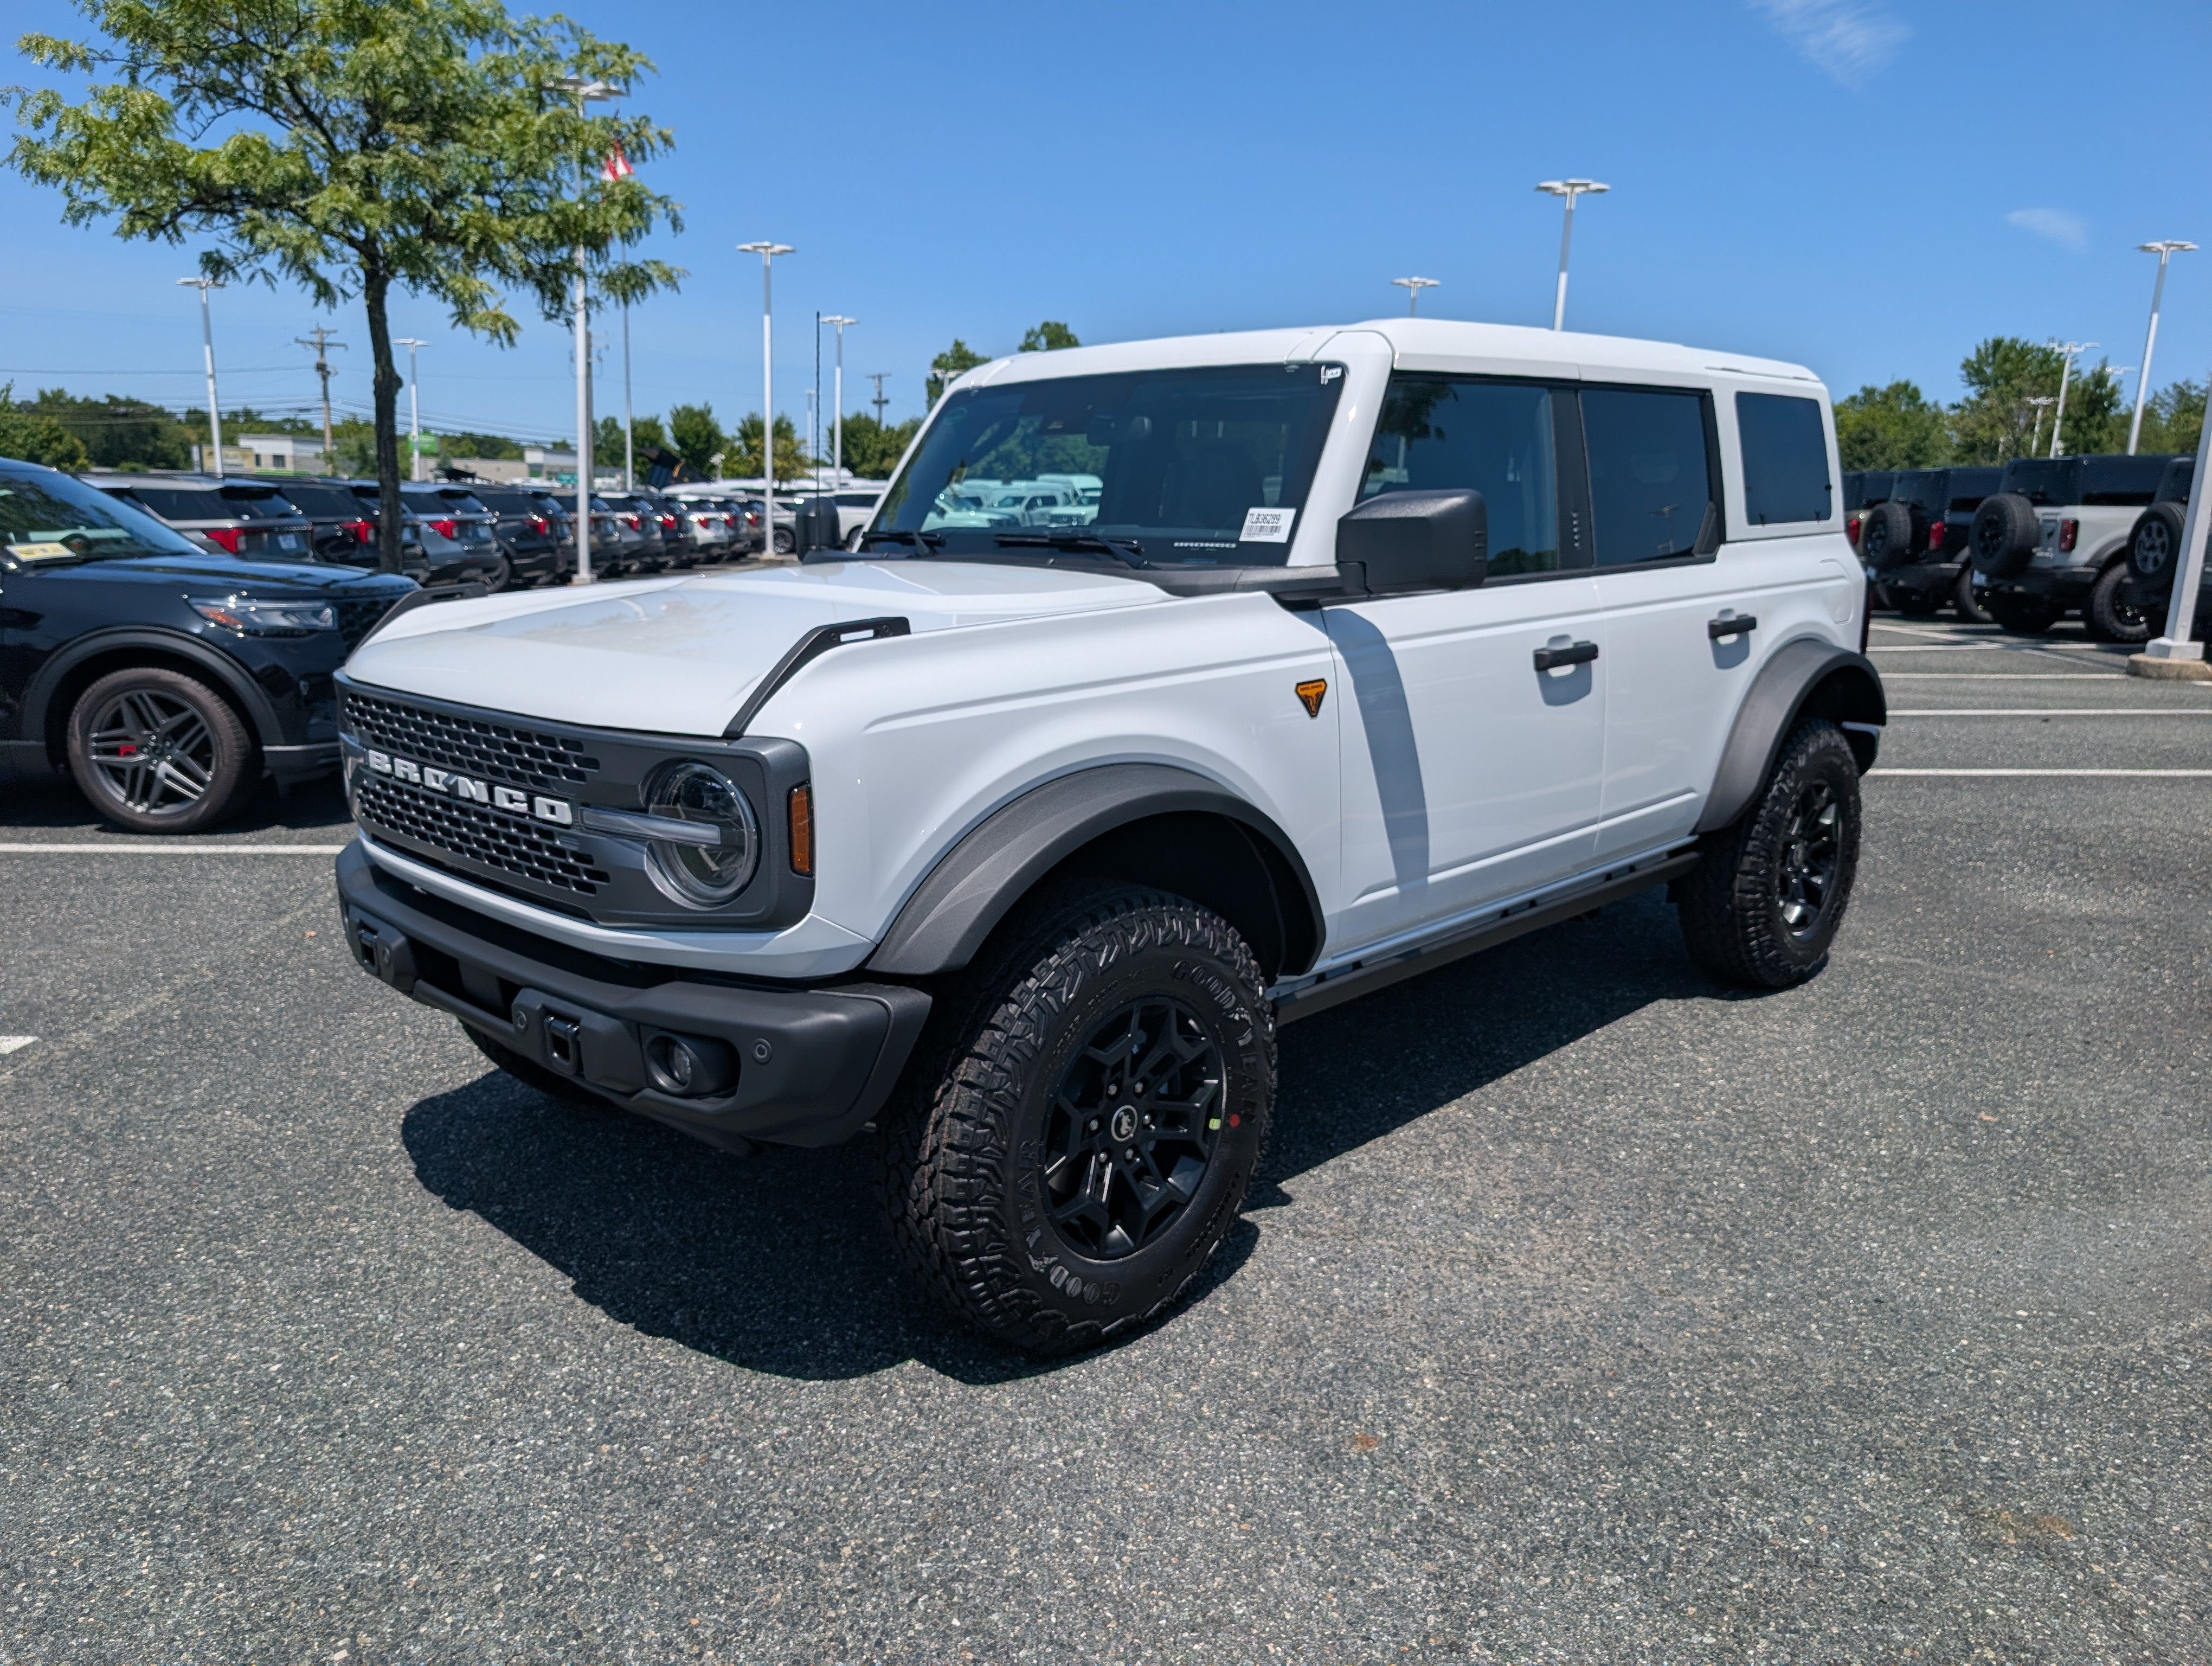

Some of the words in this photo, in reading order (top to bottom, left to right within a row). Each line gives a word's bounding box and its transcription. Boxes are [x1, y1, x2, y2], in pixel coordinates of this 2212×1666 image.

[368, 749, 573, 825] BRONCO
[1171, 960, 1258, 1126] GOODYEAR
[1017, 1139, 1121, 1305] GOODYEAR
